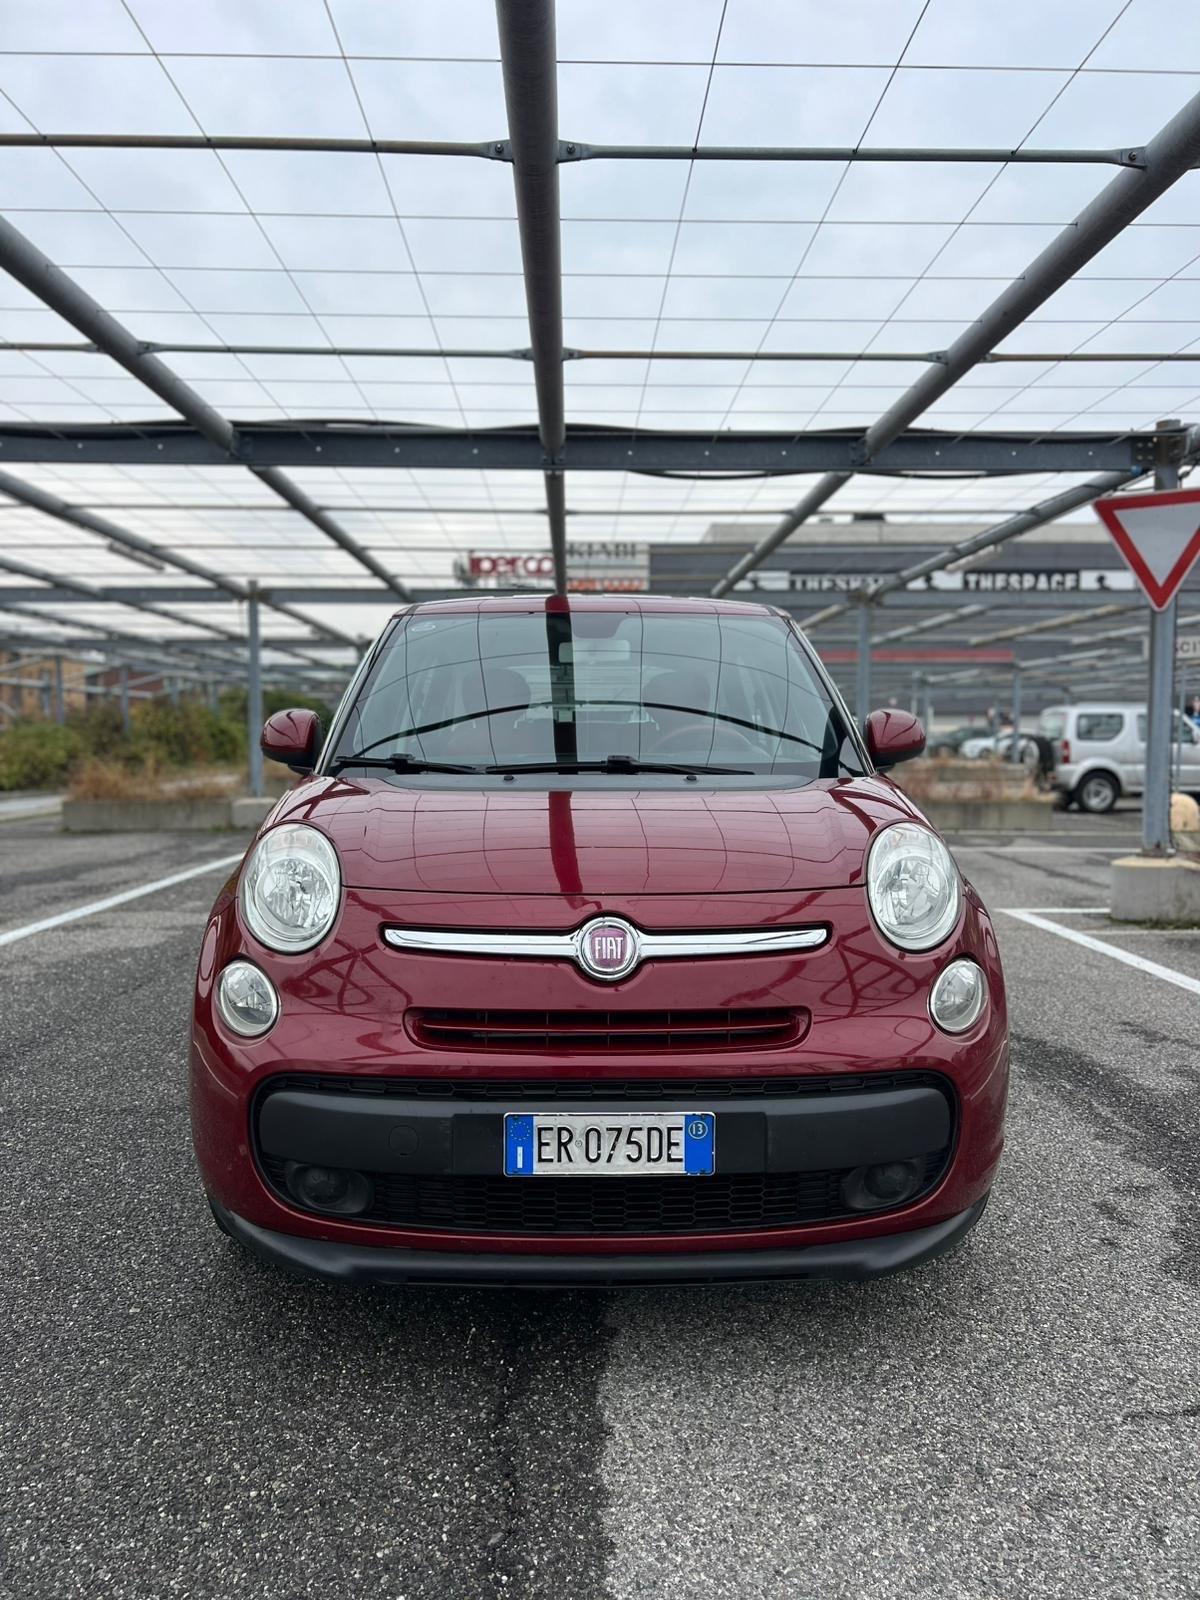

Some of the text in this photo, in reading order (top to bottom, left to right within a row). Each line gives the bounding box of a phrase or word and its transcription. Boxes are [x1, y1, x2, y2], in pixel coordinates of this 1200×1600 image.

[568, 542, 637, 560] KIABI
[594, 937, 624, 960] FIAT
[537, 1126, 684, 1163] ER 075DE
